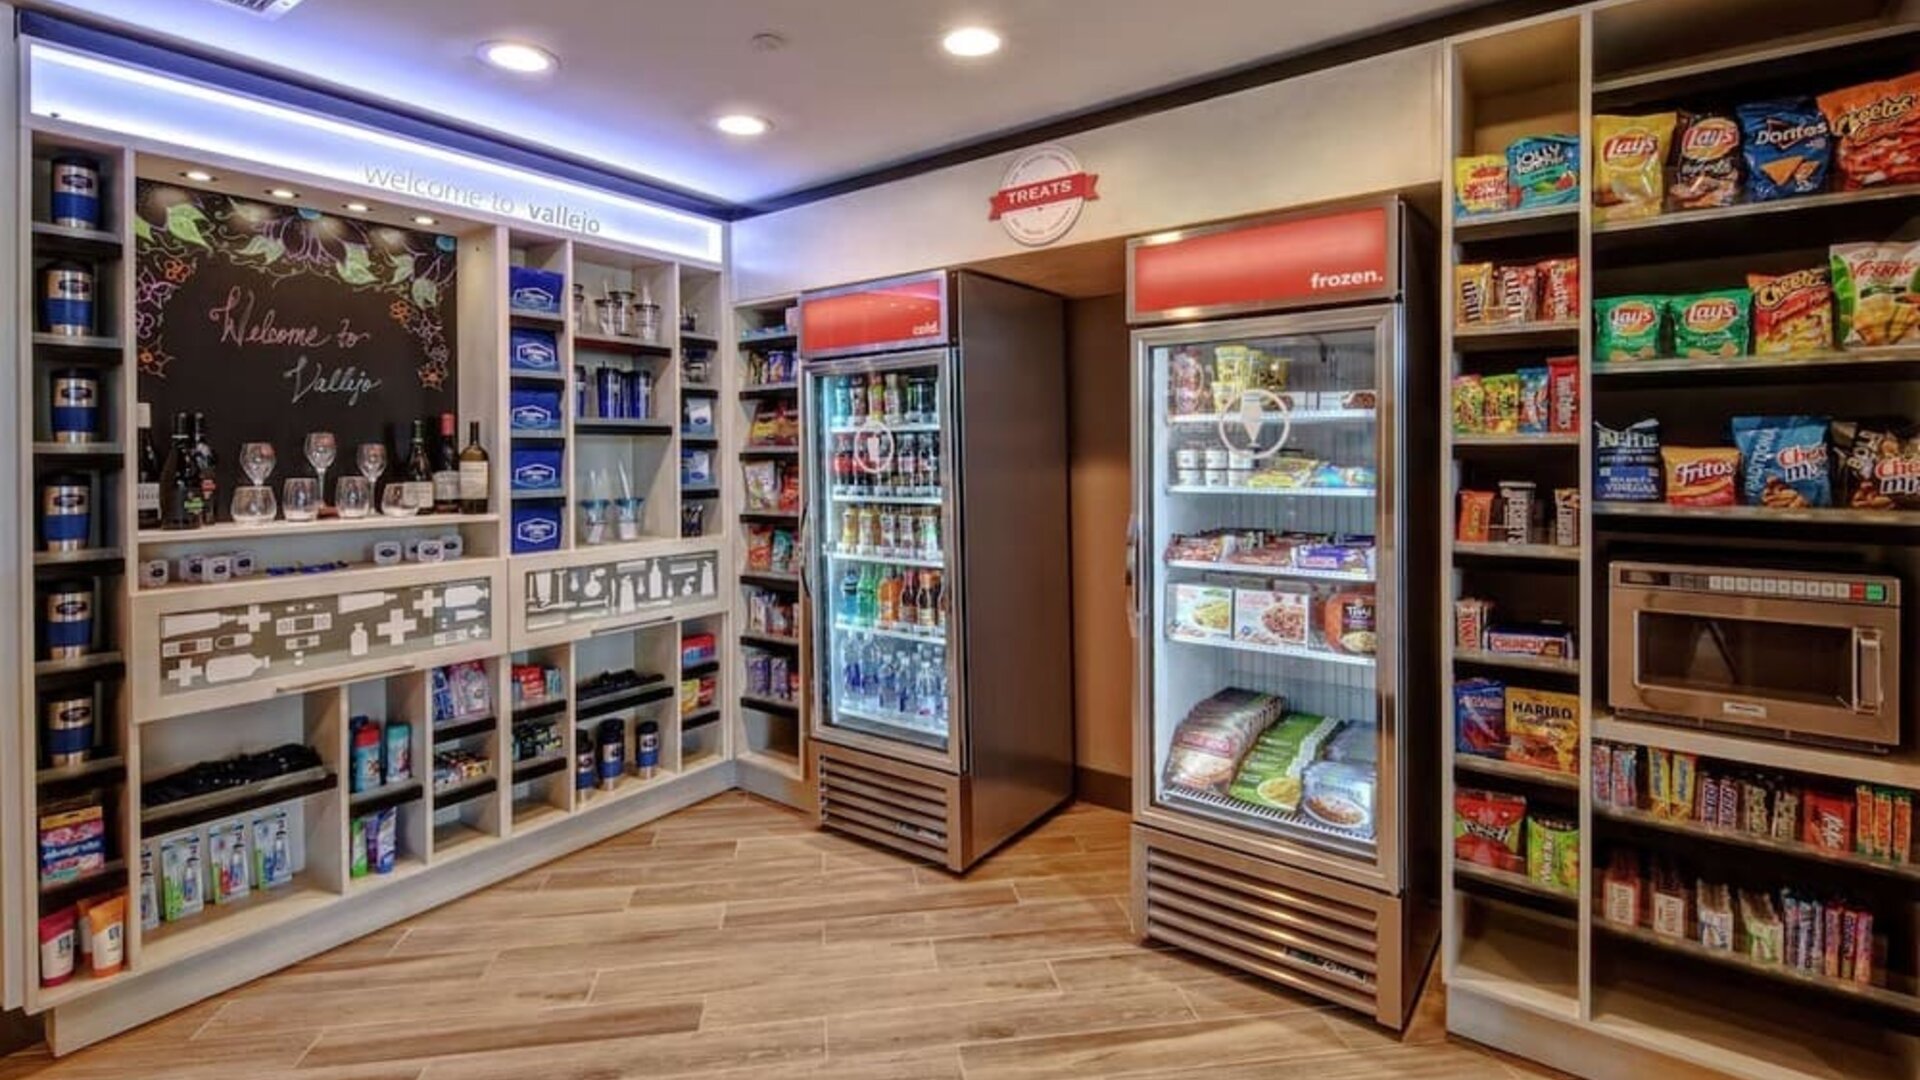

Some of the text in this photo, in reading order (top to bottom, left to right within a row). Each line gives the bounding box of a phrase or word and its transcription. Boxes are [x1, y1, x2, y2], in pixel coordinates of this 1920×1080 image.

[1837, 92, 1914, 139] Cheetos
[1754, 121, 1828, 147] Doritos
[364, 165, 601, 236] welcome to vallejo
[1006, 179, 1073, 205] TREATS
[1310, 270, 1384, 290] frozen.
[208, 285, 371, 348] Welcome to
[283, 355, 383, 407] Vallejo
[1674, 462, 1733, 487] Fritos
[1875, 456, 1920, 480] Che
[1511, 701, 1572, 721] HARIBO
